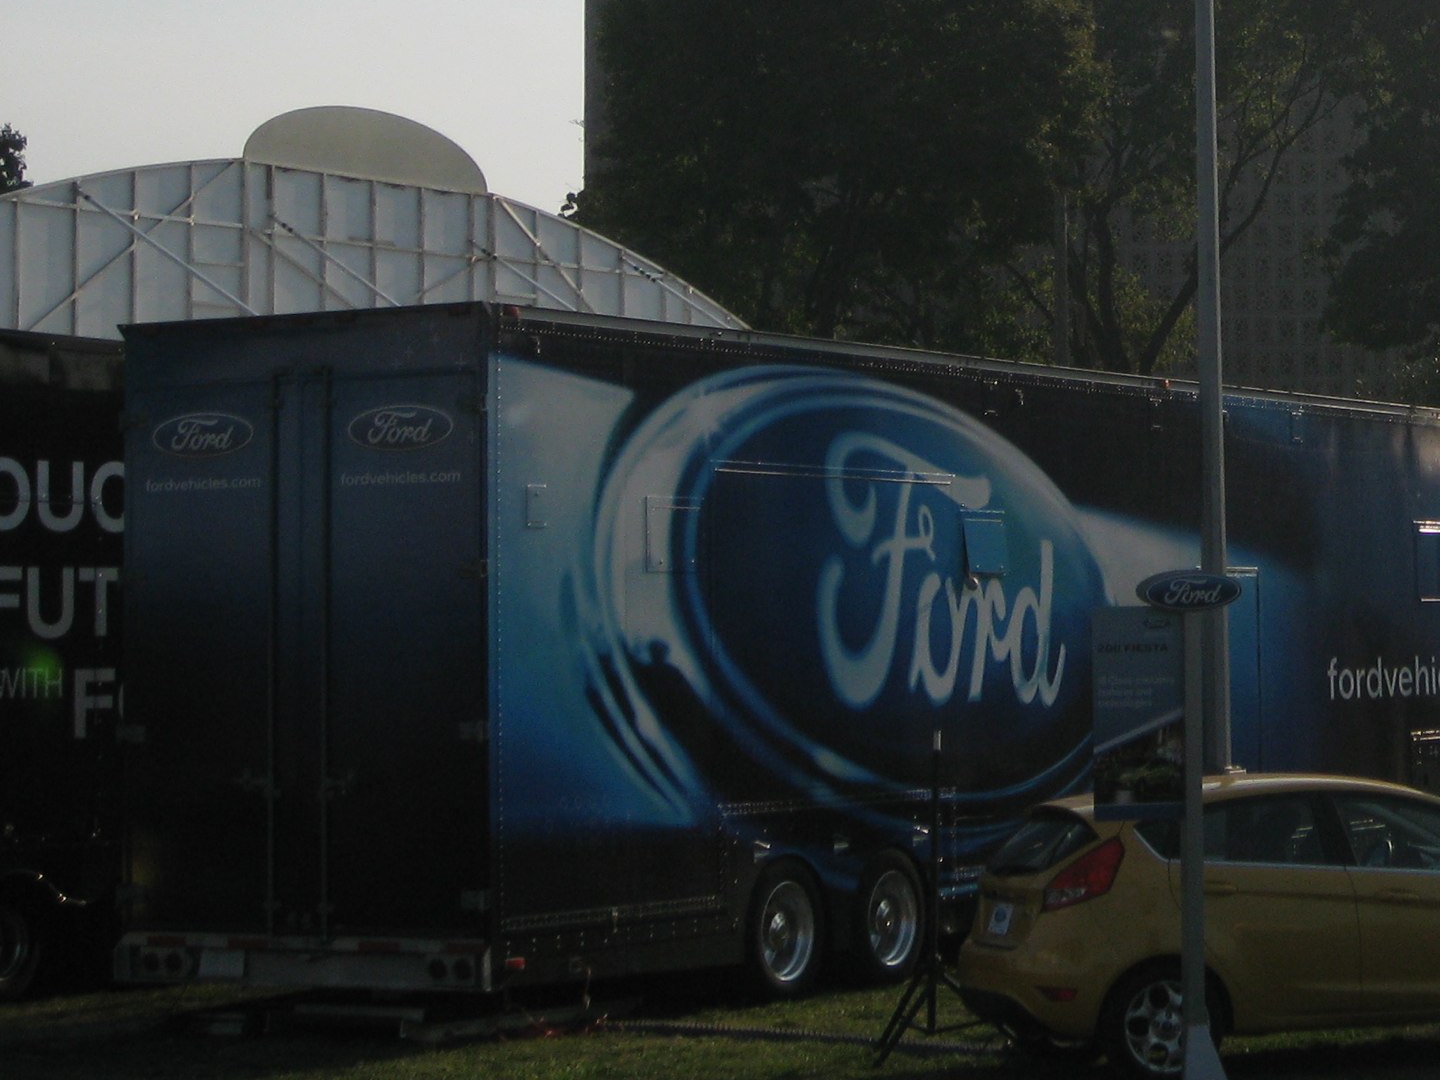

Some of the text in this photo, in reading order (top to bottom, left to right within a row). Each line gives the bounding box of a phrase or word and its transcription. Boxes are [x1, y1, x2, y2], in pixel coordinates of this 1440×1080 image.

[171, 418, 233, 451] Ford
[367, 410, 434, 444] Ford
[145, 475, 262, 493] fordvehicles.com
[340, 469, 461, 487] fordvehicles.com
[816, 431, 1066, 710] Ford
[1164, 578, 1222, 604] Ford
[74, 668, 125, 739] F
